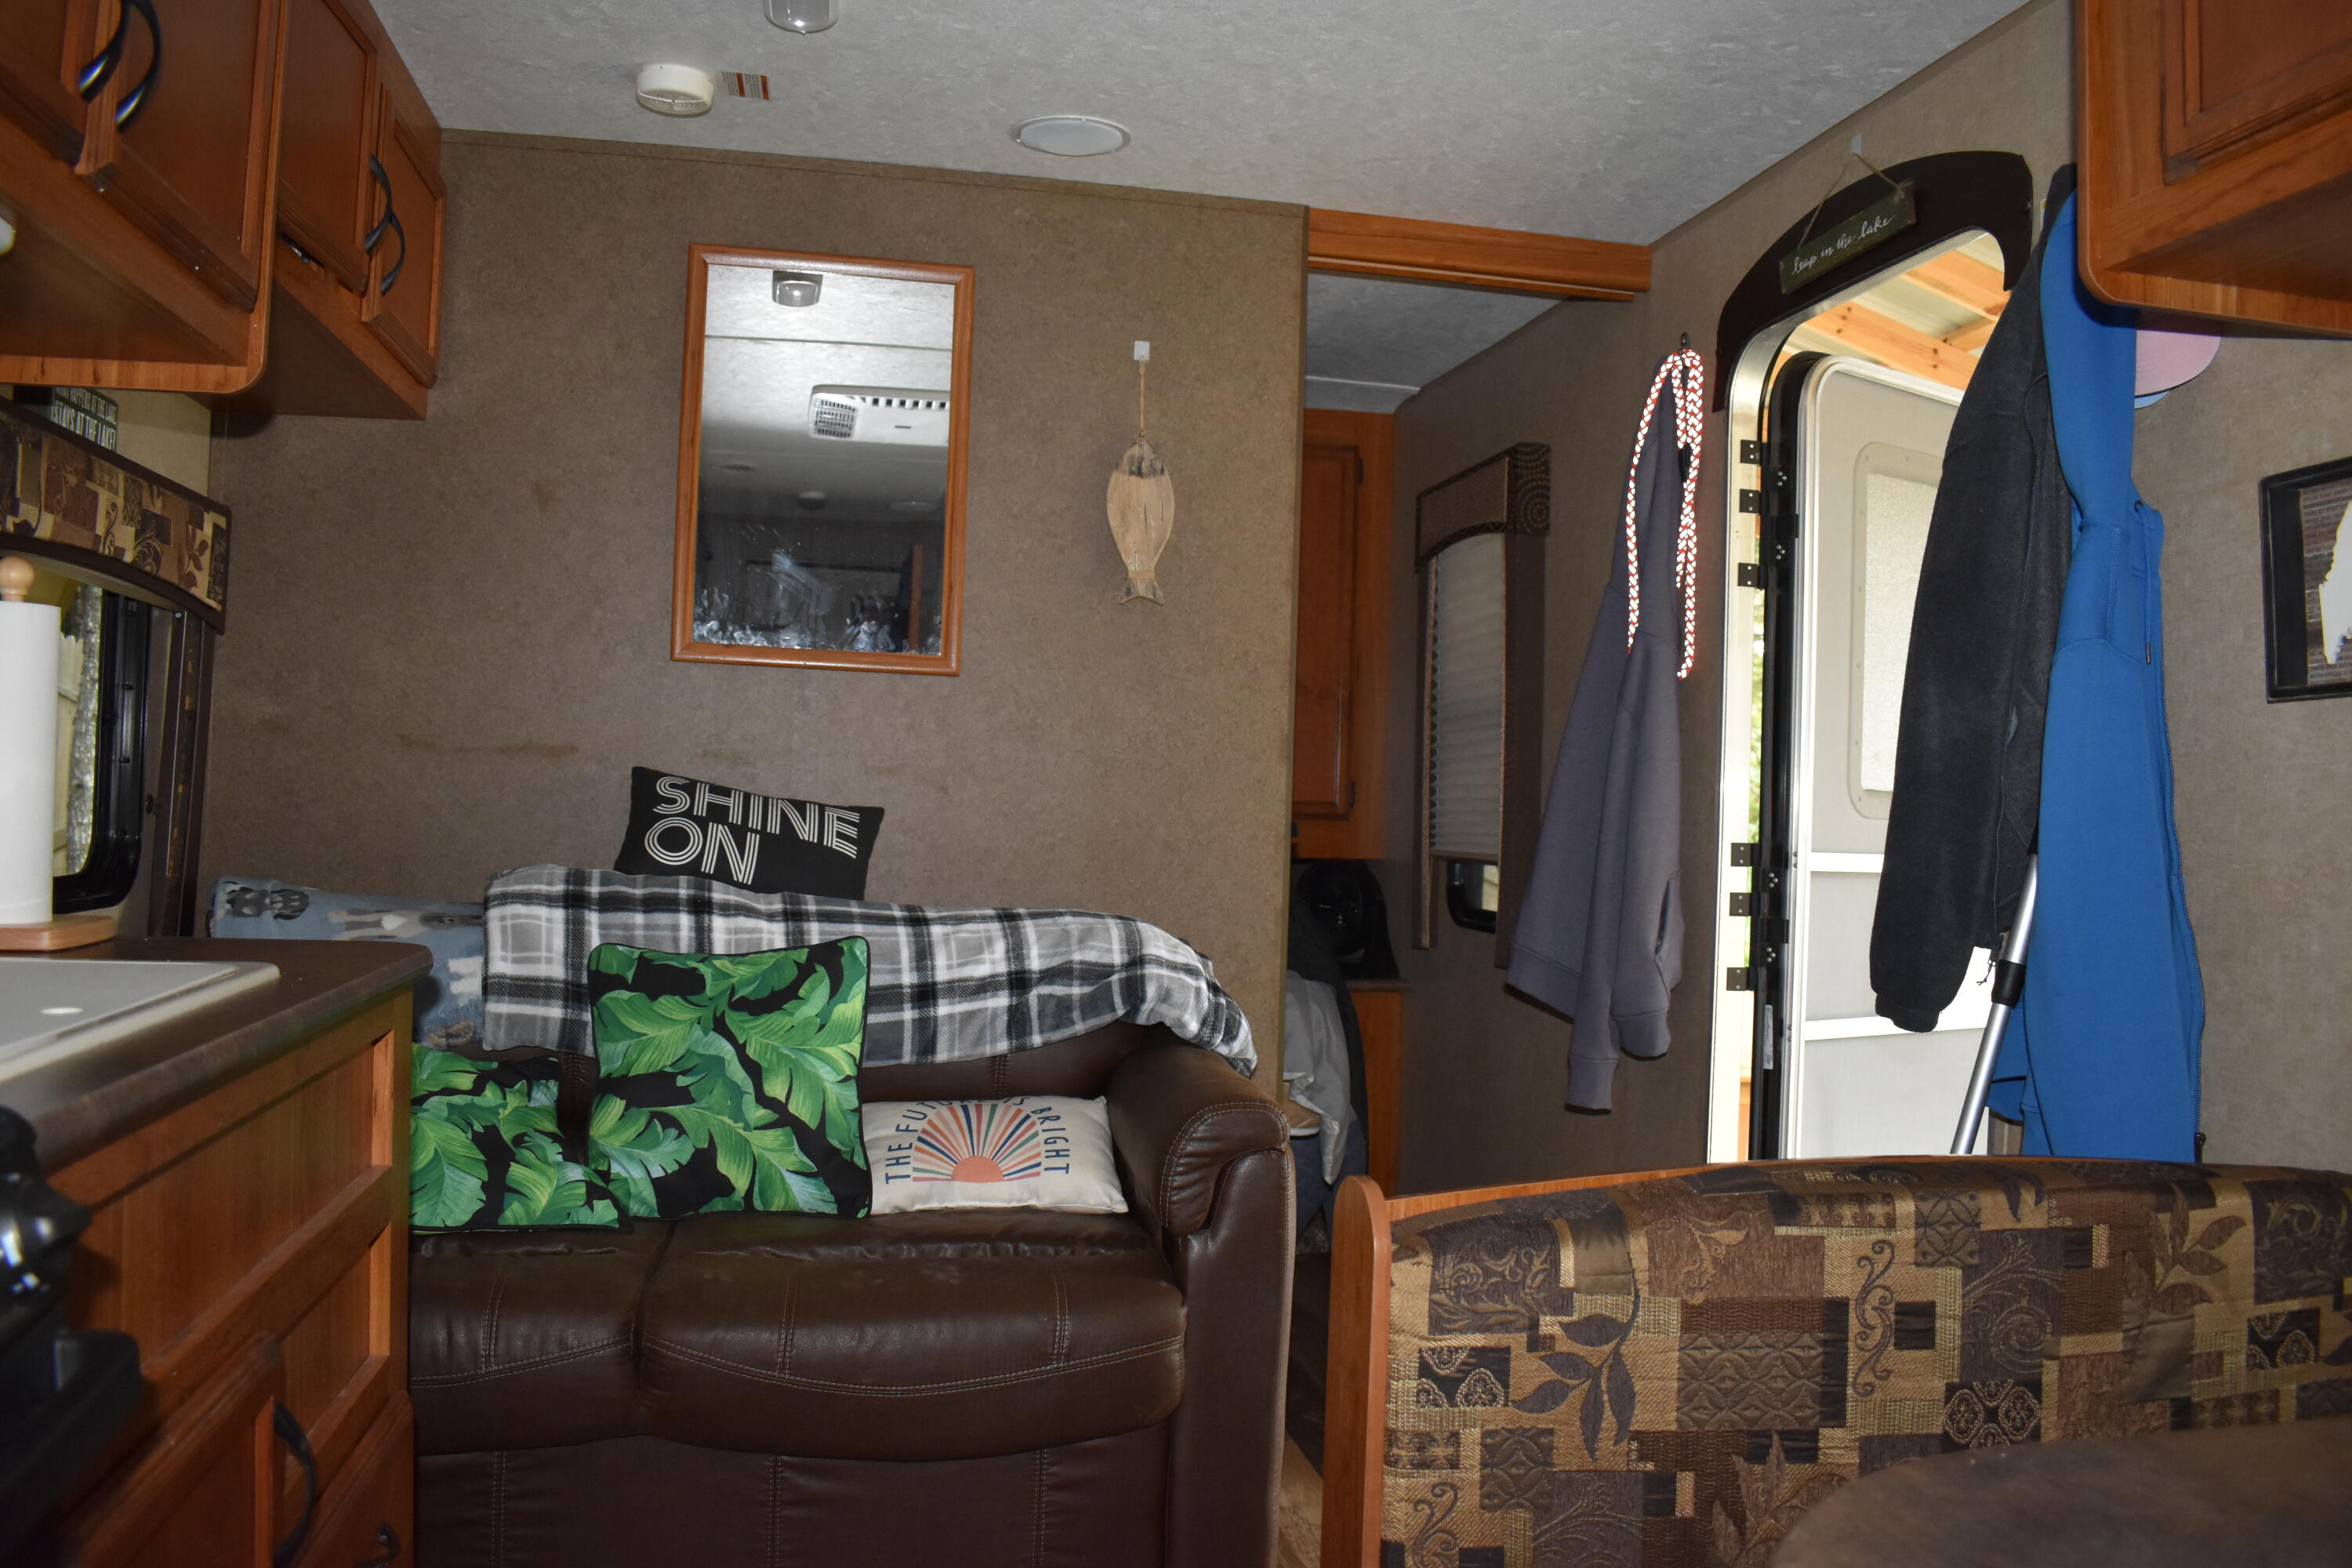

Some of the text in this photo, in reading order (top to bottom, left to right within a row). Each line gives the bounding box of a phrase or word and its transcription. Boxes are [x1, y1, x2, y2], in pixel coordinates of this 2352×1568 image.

[1791, 256, 1818, 275] leap
[1836, 233, 1857, 249] the
[1857, 214, 1897, 241] lake
[75, 412, 85, 437] AT
[644, 816, 760, 885] ON
[652, 775, 860, 859] SHINE
[884, 1142, 913, 1185] THE
[1031, 1106, 1070, 1174] BRIGHT
